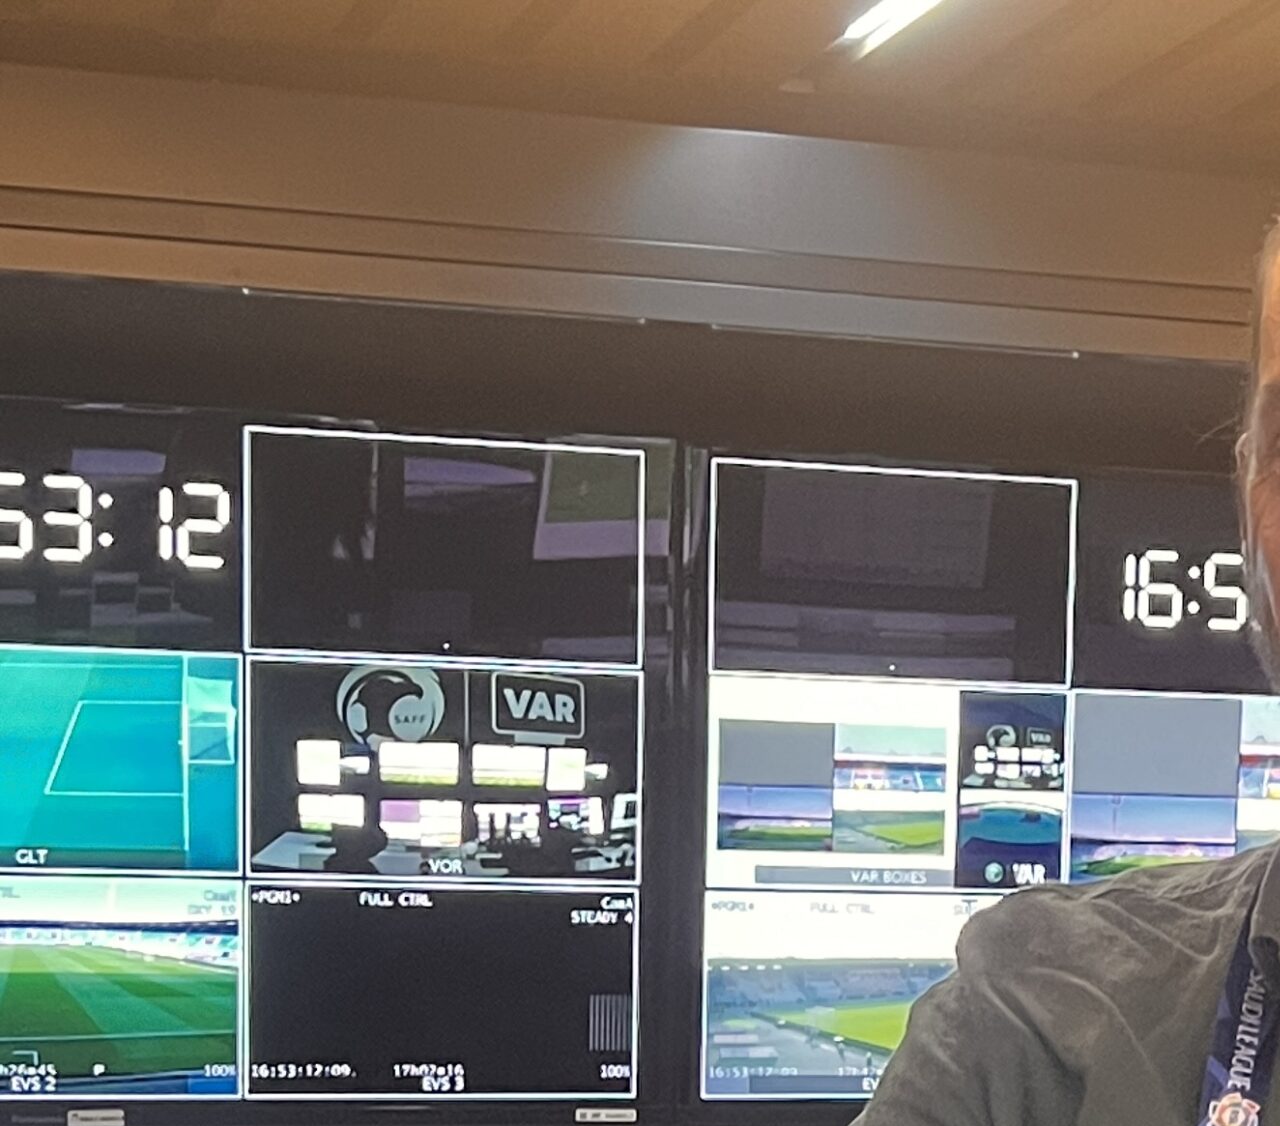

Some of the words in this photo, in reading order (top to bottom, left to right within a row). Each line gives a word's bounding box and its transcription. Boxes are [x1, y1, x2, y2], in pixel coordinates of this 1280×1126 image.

[503, 687, 576, 724] VAR
[394, 714, 427, 726] SAFF
[428, 857, 464, 873] VOR
[850, 870, 880, 883] VAR
[883, 871, 928, 884] BOXES
[1012, 863, 1047, 885] VAR
[360, 891, 394, 907] FULL
[570, 910, 619, 925] STEADY
[1227, 1023, 1260, 1092] LEAGUE
[11, 1076, 43, 1092] EVS
[45, 1077, 57, 1092] 2
[422, 1075, 450, 1091] EVS
[453, 1075, 465, 1091] 3
